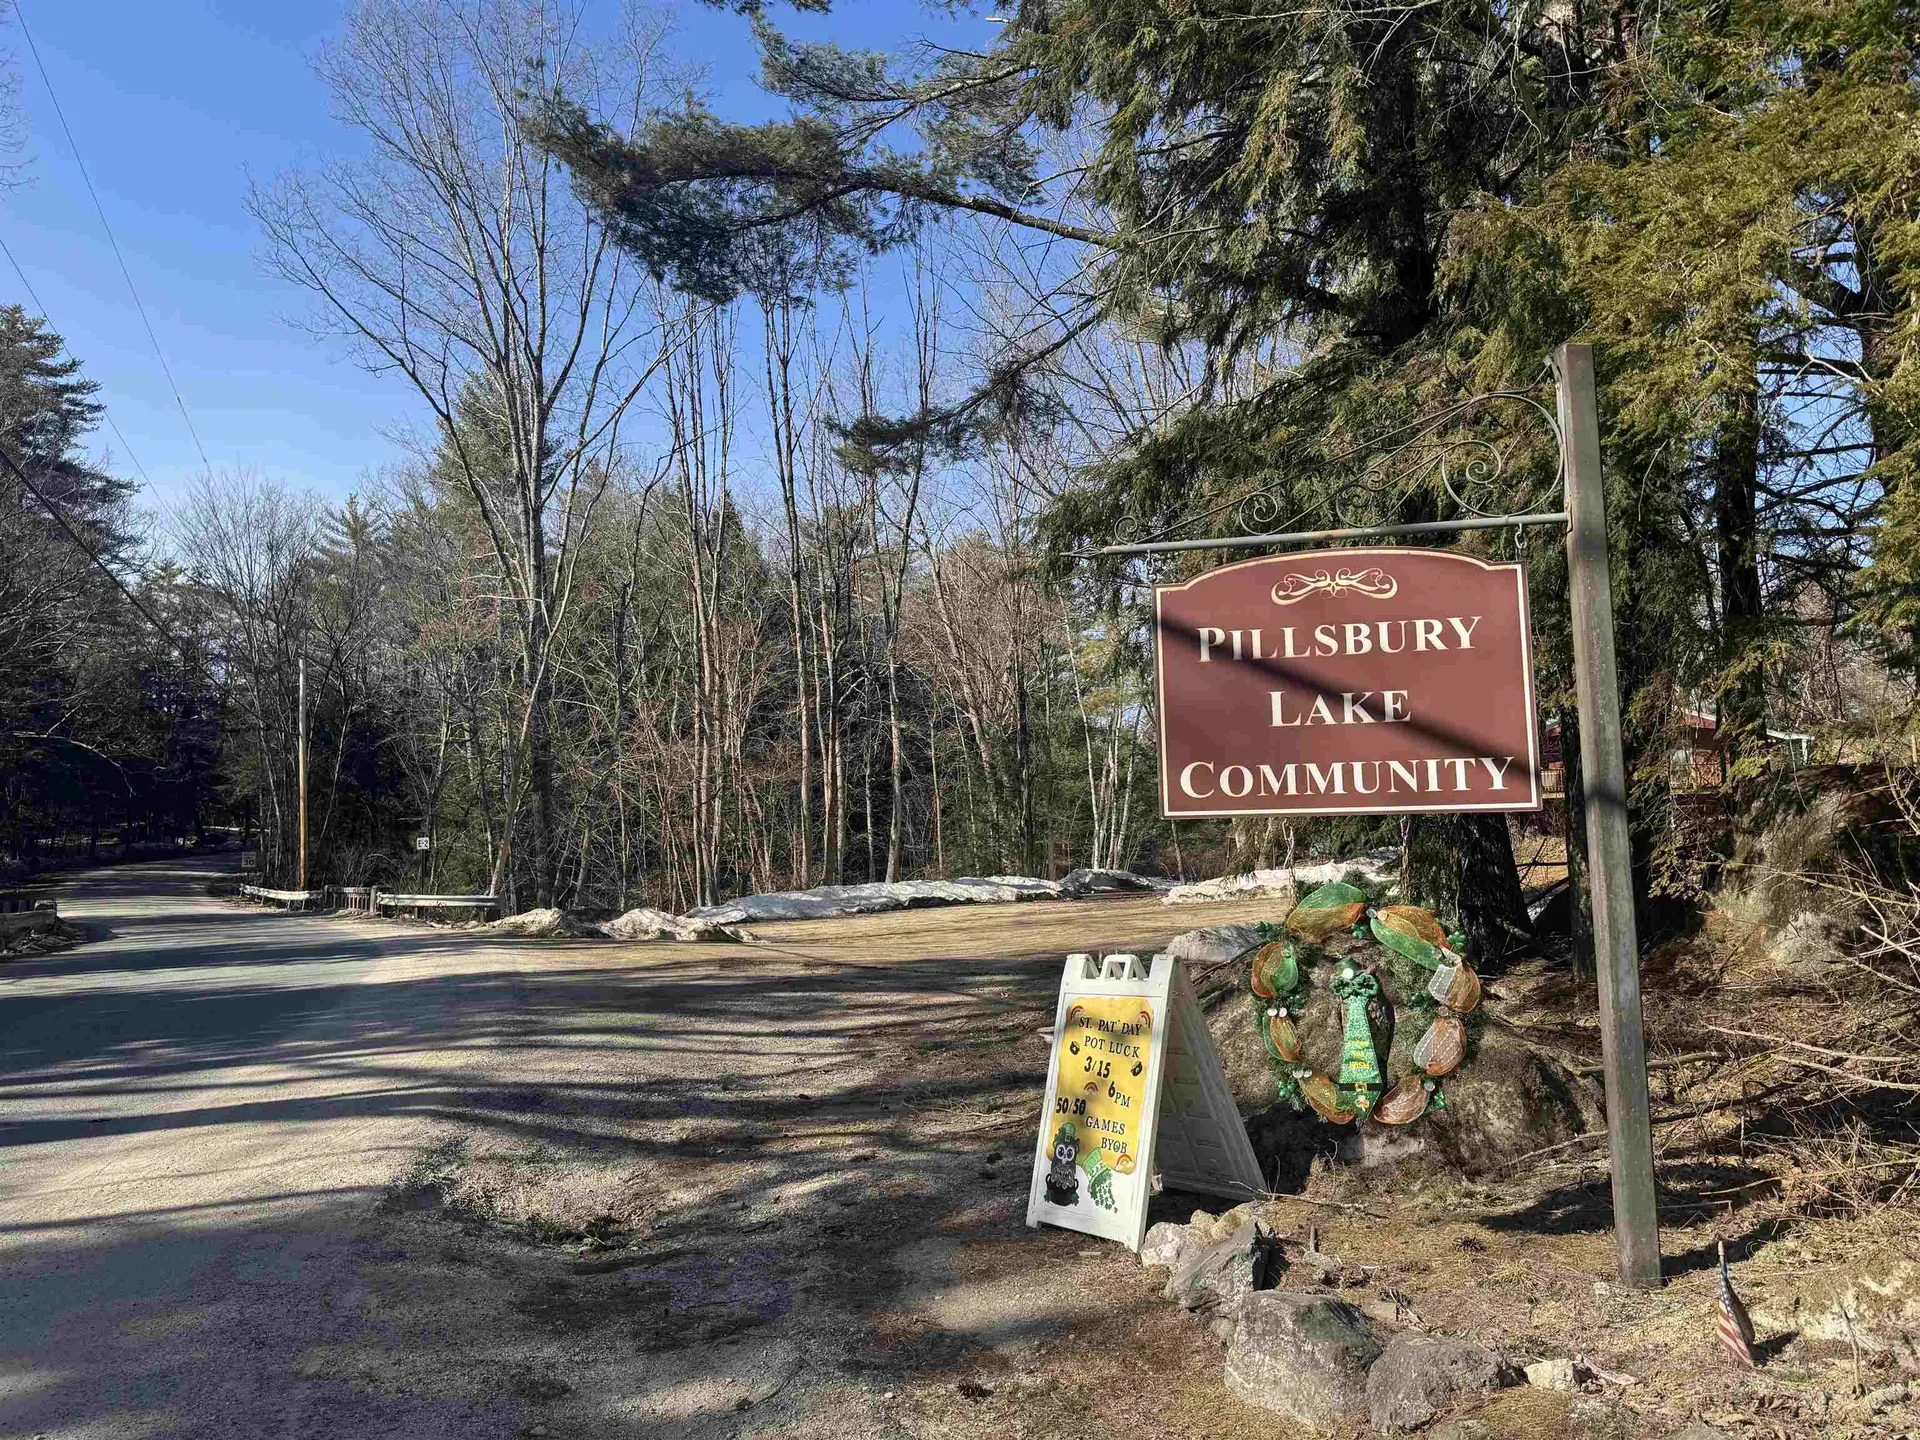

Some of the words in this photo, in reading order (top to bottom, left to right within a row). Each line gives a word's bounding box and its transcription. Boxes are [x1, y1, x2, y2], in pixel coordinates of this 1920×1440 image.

[1195, 616, 1483, 663] PILLSBURY
[1267, 689, 1412, 728] LAKE
[1179, 756, 1515, 799] COMMUNITY
[1120, 1022, 1143, 1036] DAY
[1083, 1035, 1106, 1051] POT
[1108, 1041, 1141, 1059] LUCK
[1083, 1055, 1112, 1079] 3/15
[1085, 1115, 1126, 1136] GAMES
[1100, 1136, 1128, 1154] BYOB
